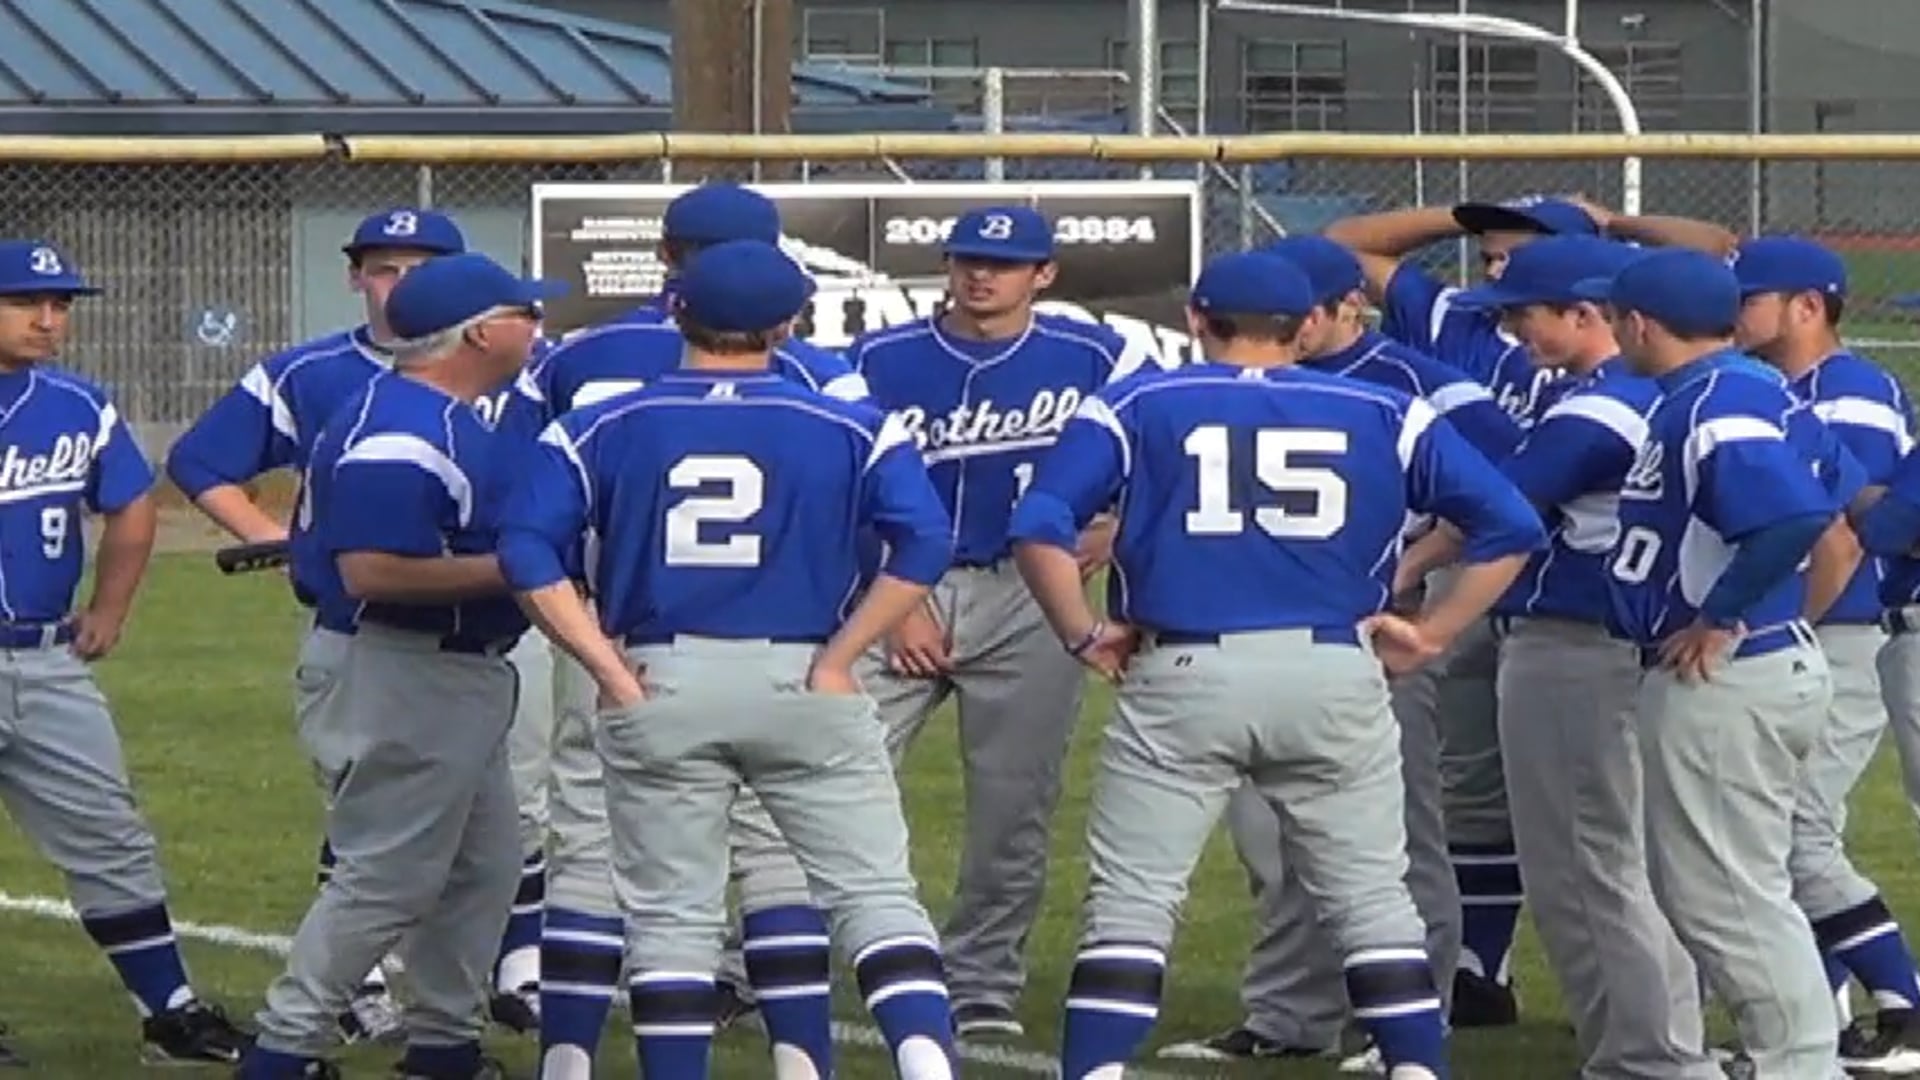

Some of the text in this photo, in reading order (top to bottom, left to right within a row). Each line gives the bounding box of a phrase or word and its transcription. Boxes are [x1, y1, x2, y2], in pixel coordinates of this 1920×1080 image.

[383, 211, 418, 237] B
[978, 215, 1014, 239] B
[0, 431, 90, 487] hell
[1184, 425, 1348, 538] 15
[41, 507, 67, 559] 9
[665, 454, 763, 567] 2
